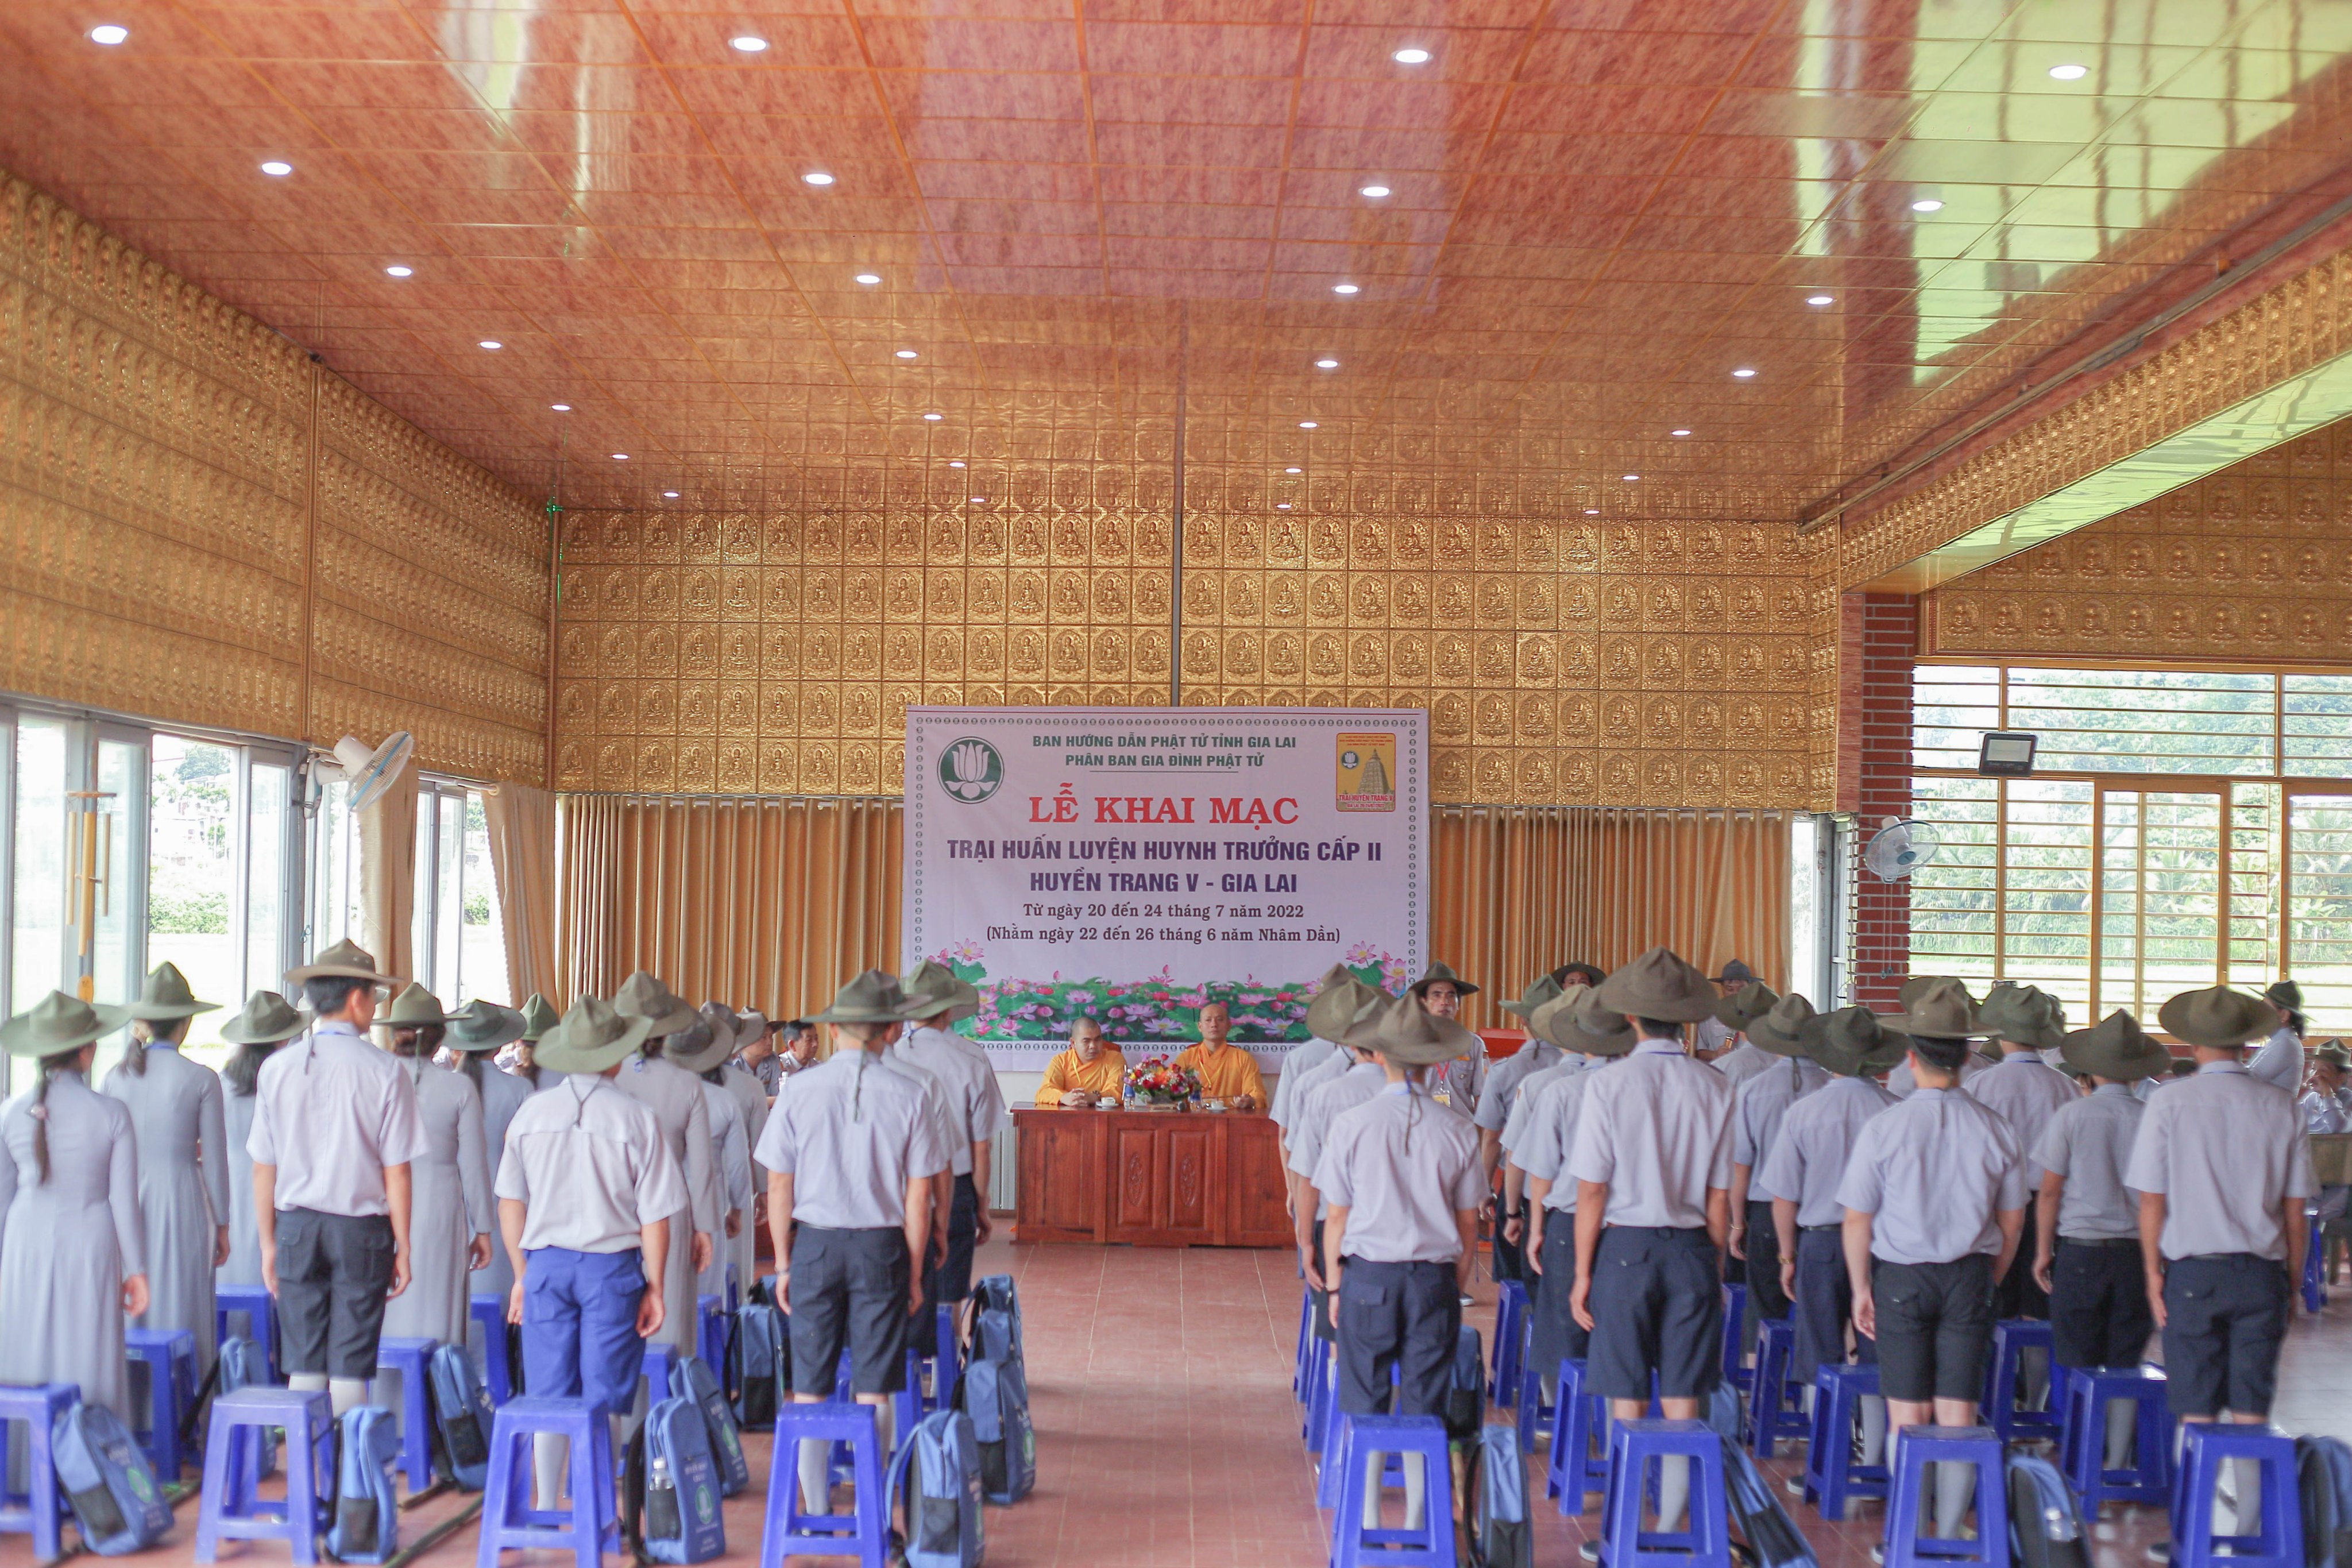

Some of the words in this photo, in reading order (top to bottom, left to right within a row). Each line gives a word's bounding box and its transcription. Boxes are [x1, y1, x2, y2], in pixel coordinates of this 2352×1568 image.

[1033, 736, 1061, 747] BAN
[1066, 733, 1113, 747] HƯỚNG
[1118, 732, 1146, 747] DẪN
[1151, 734, 1187, 750] PHẬT
[1191, 733, 1209, 747] TỬ
[1211, 733, 1243, 748] TỈNH
[1248, 737, 1271, 748] GIA
[1275, 737, 1296, 748] LAI
[1065, 752, 1103, 766] PHÂN
[1108, 755, 1137, 766] BAN
[1141, 755, 1164, 766] GIA
[1168, 754, 1202, 767] ĐÌNH
[1207, 753, 1242, 768] PHẬT
[1246, 752, 1265, 767] TỬ
[1029, 782, 1079, 822] LỄ
[1094, 797, 1195, 823] KHAI
[1209, 797, 1299, 831] MẠC
[947, 840, 995, 863] TRẠI
[1002, 833, 1061, 859] HUẤN
[1069, 836, 1136, 864] LUYỆN
[1144, 841, 1216, 860] HUYNH
[1223, 835, 1310, 861] TRƯỞNG
[1317, 835, 1360, 861] CẤP
[1368, 842, 1381, 861] II
[1030, 866, 1101, 891] HUYỀN
[1108, 872, 1179, 892] TRANG
[1185, 873, 1199, 892] V
[1221, 873, 1258, 893] GIA
[1265, 874, 1297, 893] LAI
[1023, 903, 1044, 916] Từ
[1047, 903, 1083, 920] ngày
[1088, 904, 1106, 917] 20
[1111, 901, 1139, 917] đến
[1144, 904, 1163, 917] 24
[1168, 903, 1211, 921] tháng
[1215, 905, 1225, 917] 7
[1229, 905, 1262, 918] năm
[1267, 905, 1304, 918] 2022
[987, 923, 1034, 941] (Nhằm
[1038, 927, 1075, 944] ngày
[1079, 928, 1098, 940] 22
[1103, 925, 1130, 940] đến
[1136, 928, 1154, 941] 26
[1159, 928, 1202, 945] tháng
[1207, 928, 1216, 941] 6
[1221, 928, 1254, 941] năm
[1258, 928, 1301, 941] Nhâm
[1306, 925, 1340, 944] Dần)
